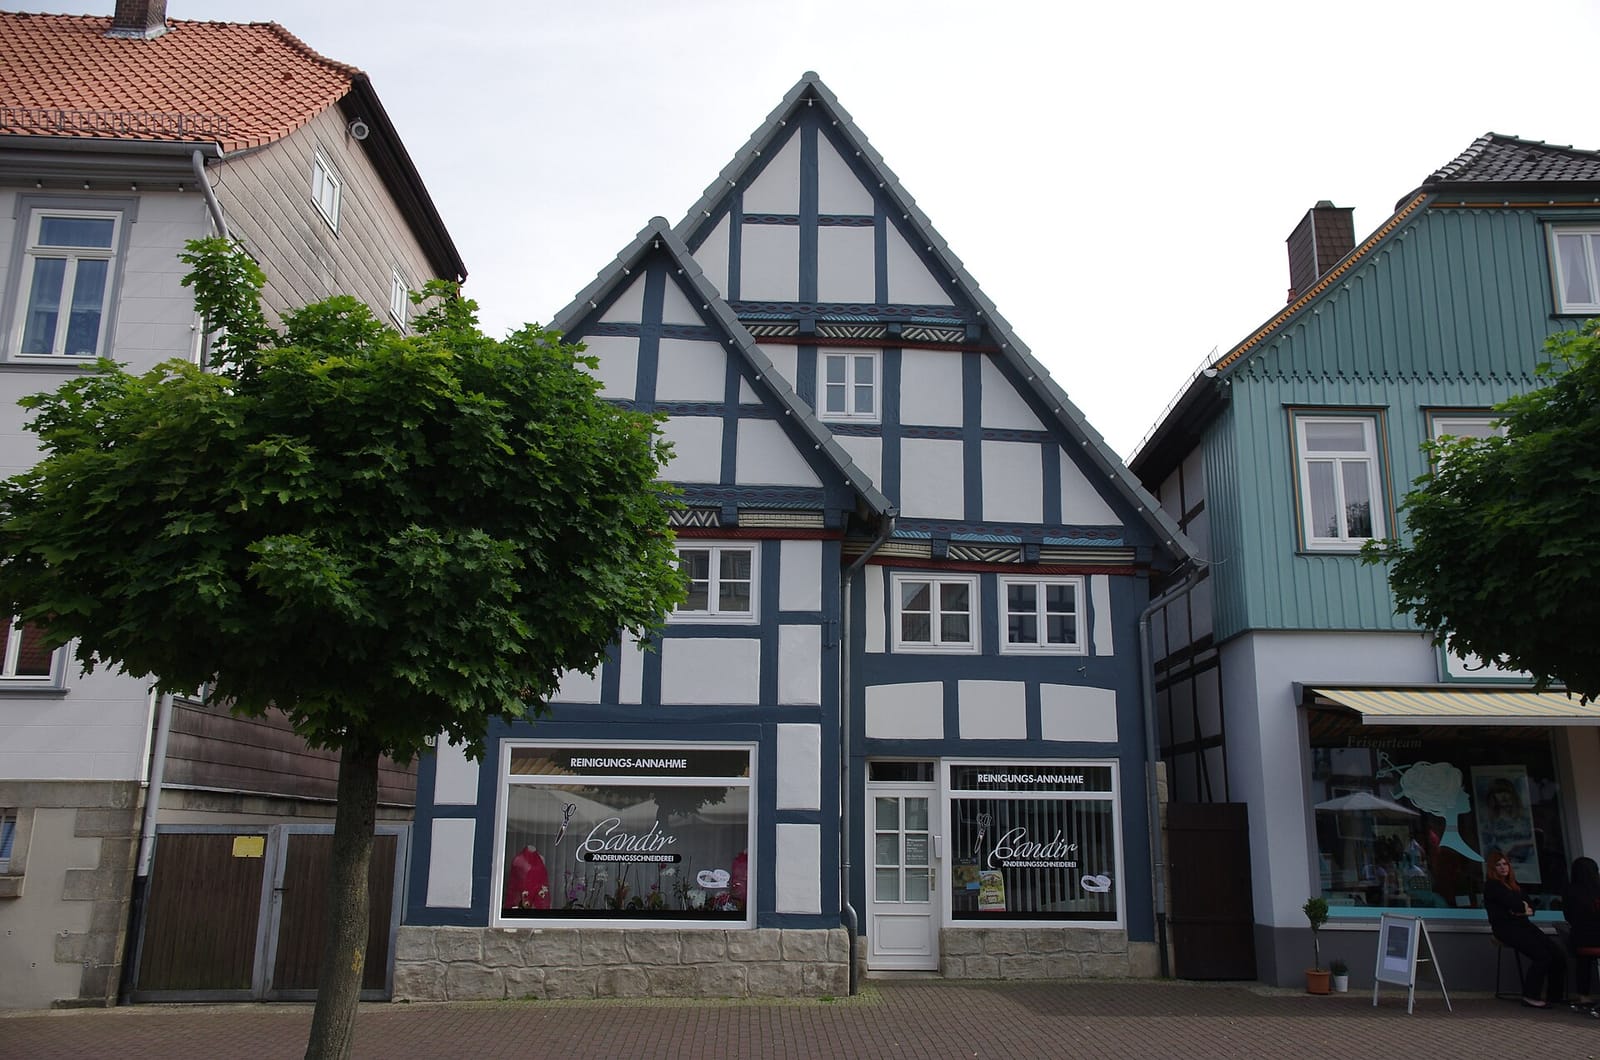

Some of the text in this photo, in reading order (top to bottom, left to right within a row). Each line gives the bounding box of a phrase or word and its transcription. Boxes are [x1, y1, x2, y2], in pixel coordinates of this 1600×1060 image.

[570, 757, 687, 769] REINIGUNGS-ANNAHME
[977, 774, 1084, 785] REINIGUNGS-ANNAHME
[575, 817, 677, 863] Candir
[987, 826, 1078, 869] Candir
[592, 853, 674, 863] ÄNDERUNGSSCHNEIDEREI
[1002, 859, 1077, 869] ÄNDERUNGSSCHNEIDEREI
